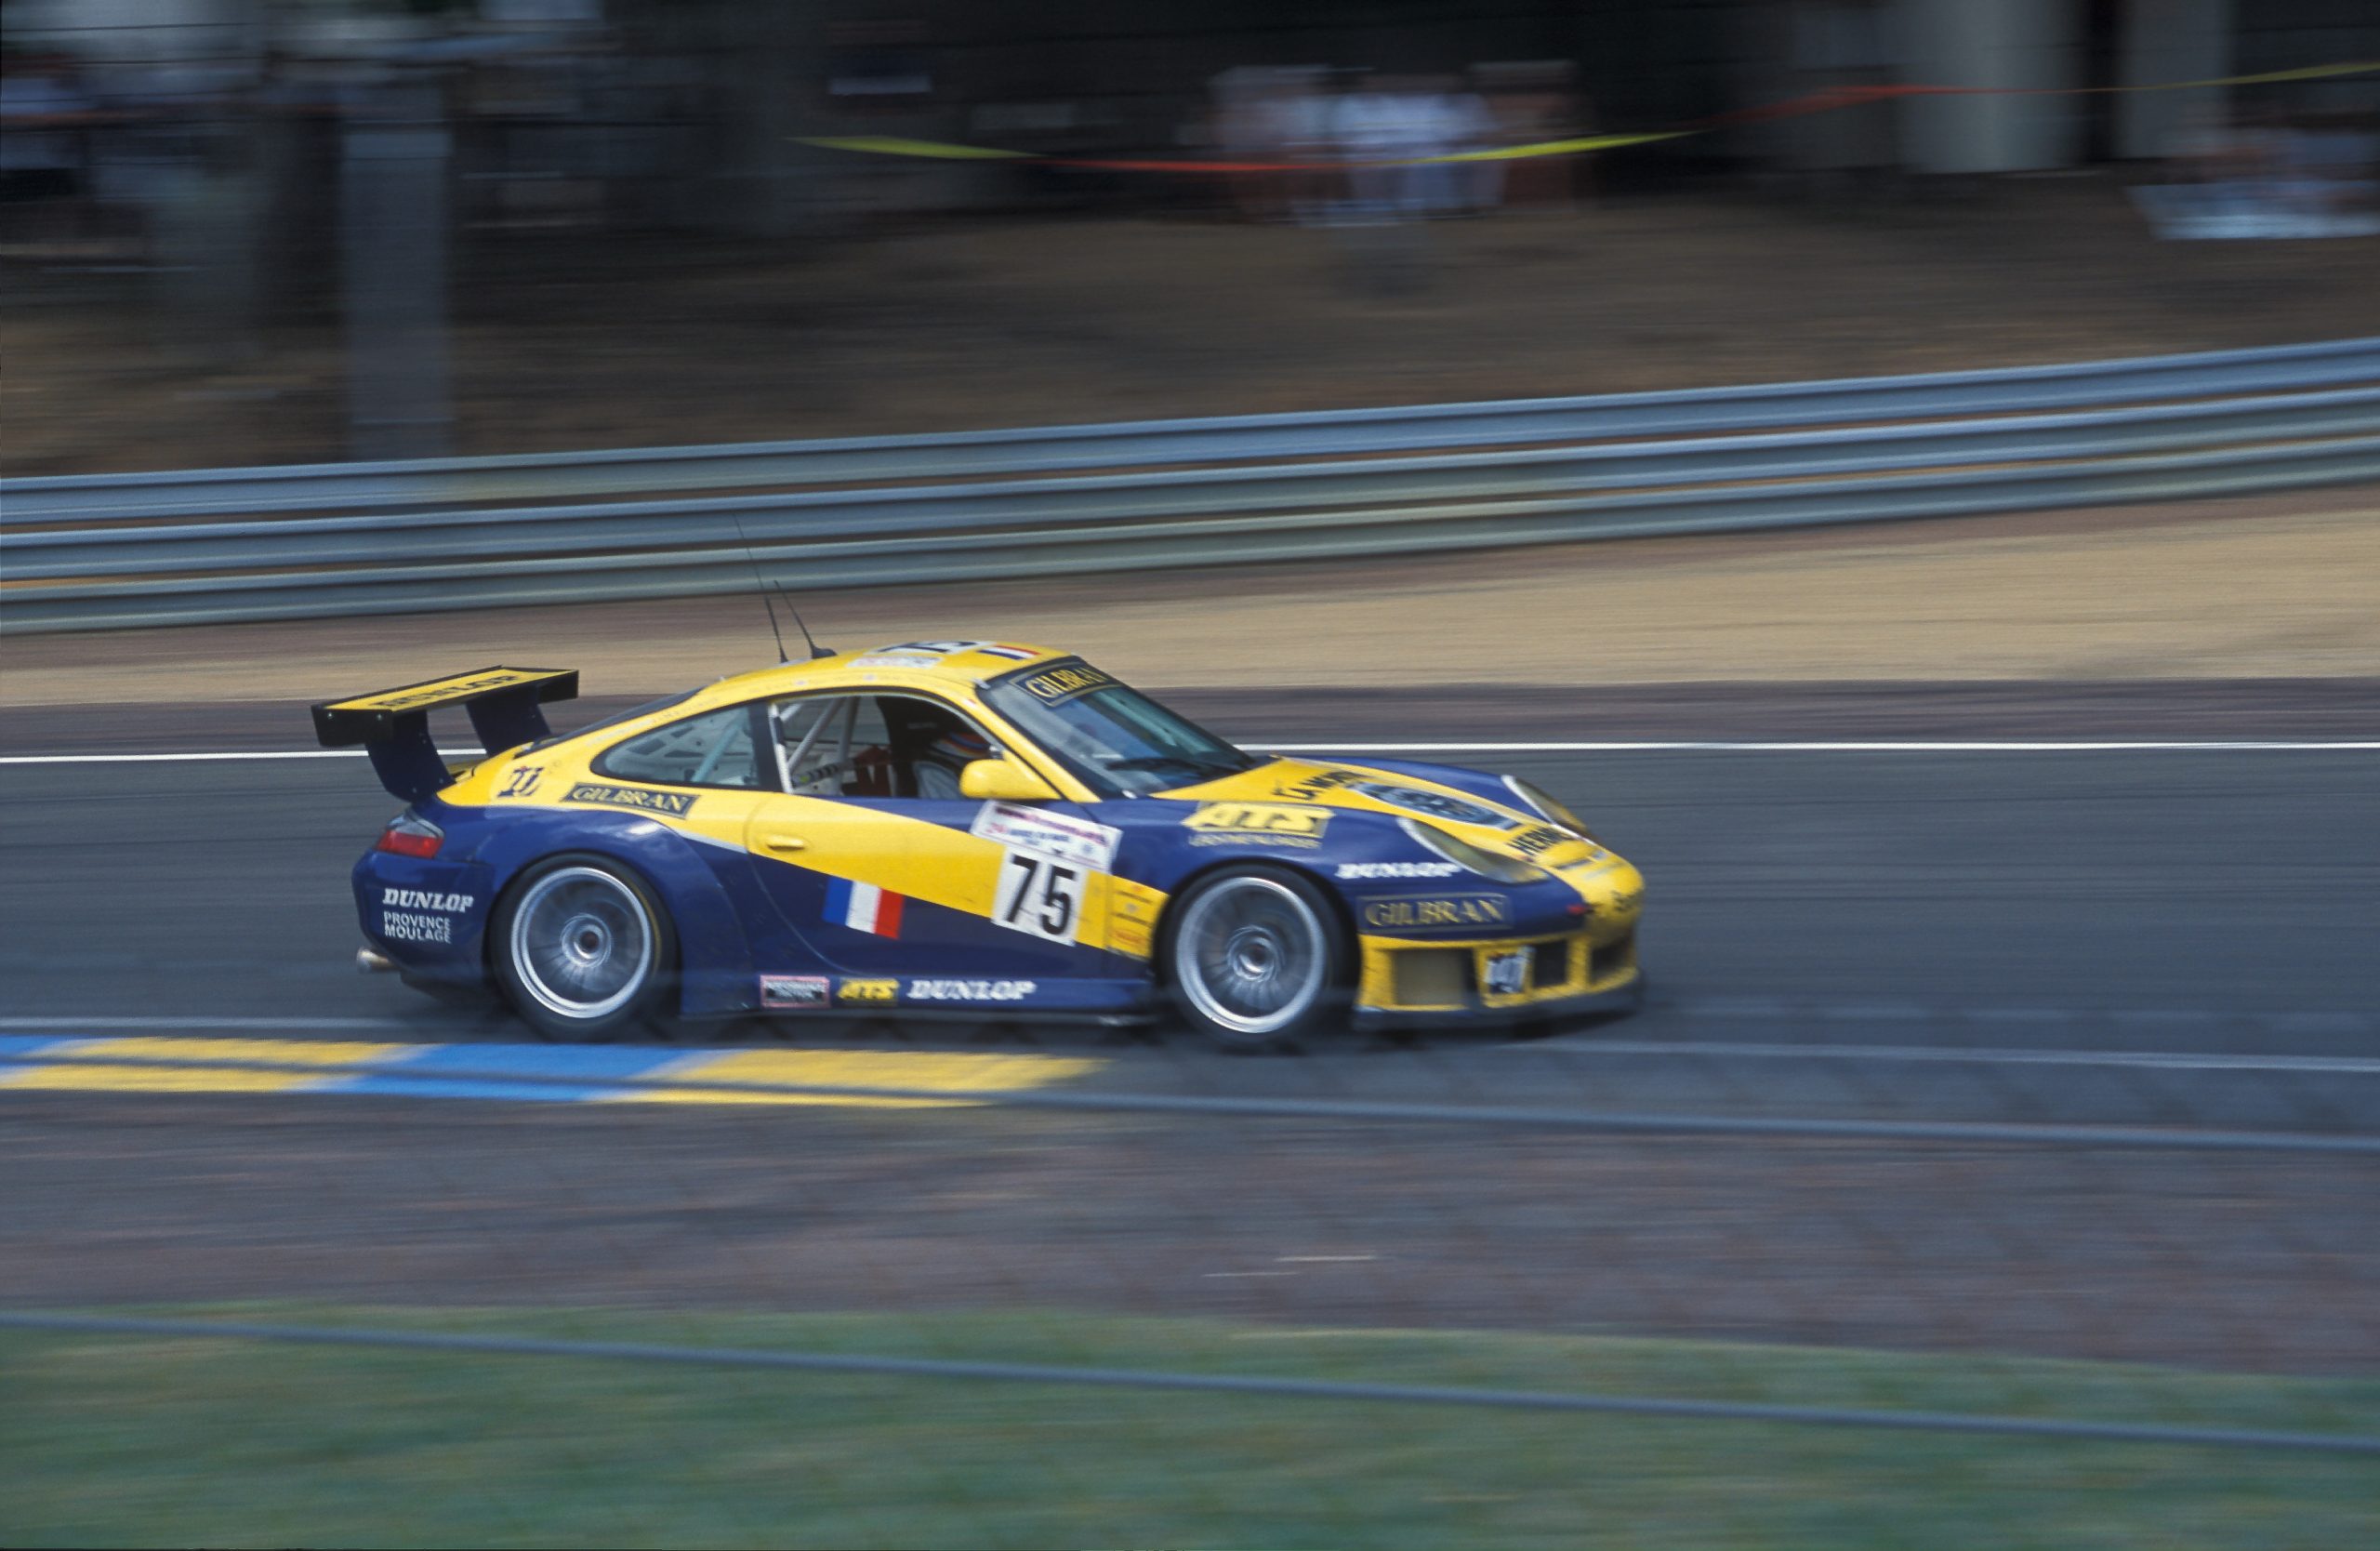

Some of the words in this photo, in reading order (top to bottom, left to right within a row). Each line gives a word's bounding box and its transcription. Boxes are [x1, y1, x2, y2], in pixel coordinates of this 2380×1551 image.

[572, 787, 688, 812] GILBRAN
[1335, 862, 1461, 878] DUNLOP
[382, 888, 474, 912] DUNLOP
[1005, 854, 1078, 935] 75
[383, 910, 452, 931] PROVENCE
[1365, 898, 1504, 926] GILBRAN
[384, 923, 453, 944] MOULAGE
[906, 979, 1038, 1001] DUNLOP
